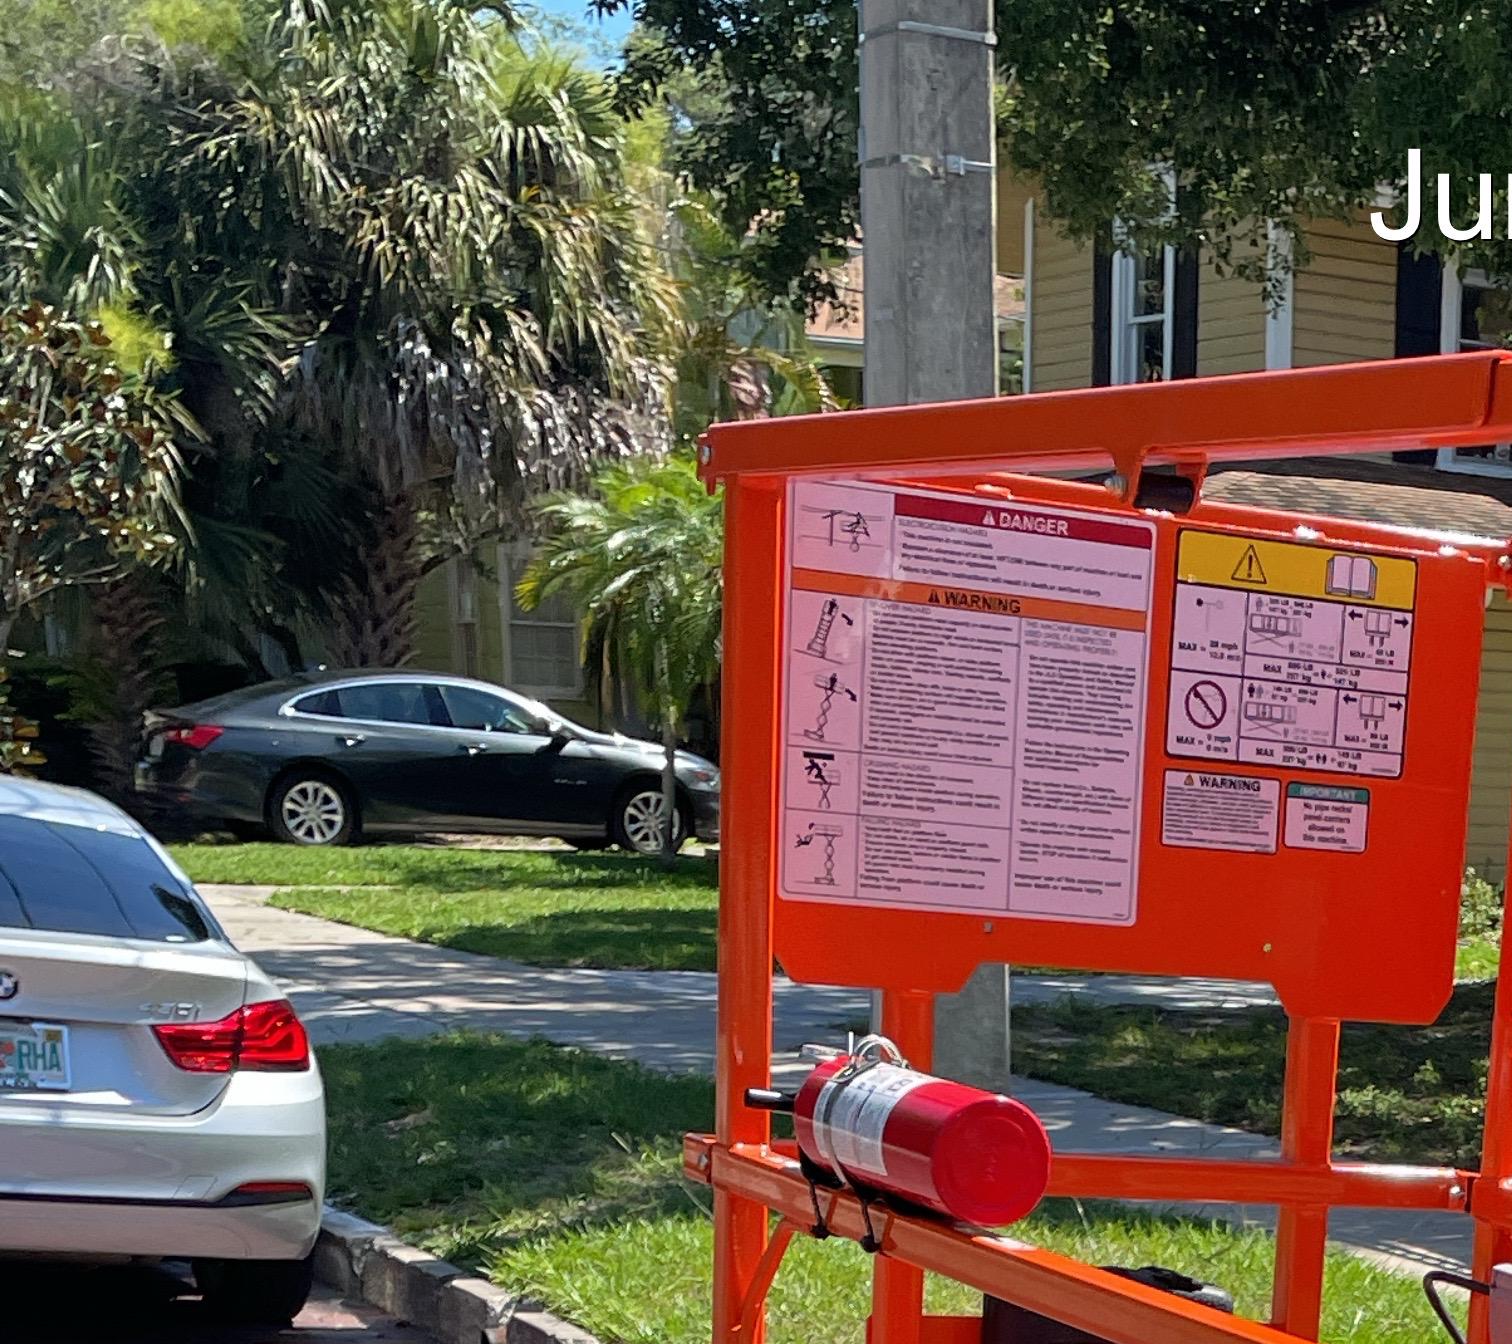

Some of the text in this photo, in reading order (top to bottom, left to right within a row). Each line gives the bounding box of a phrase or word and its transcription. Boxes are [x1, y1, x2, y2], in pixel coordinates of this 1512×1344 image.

[1000, 512, 1068, 536] DANGER
[945, 591, 1021, 614] WARNING
[1199, 776, 1260, 792] WARNING
